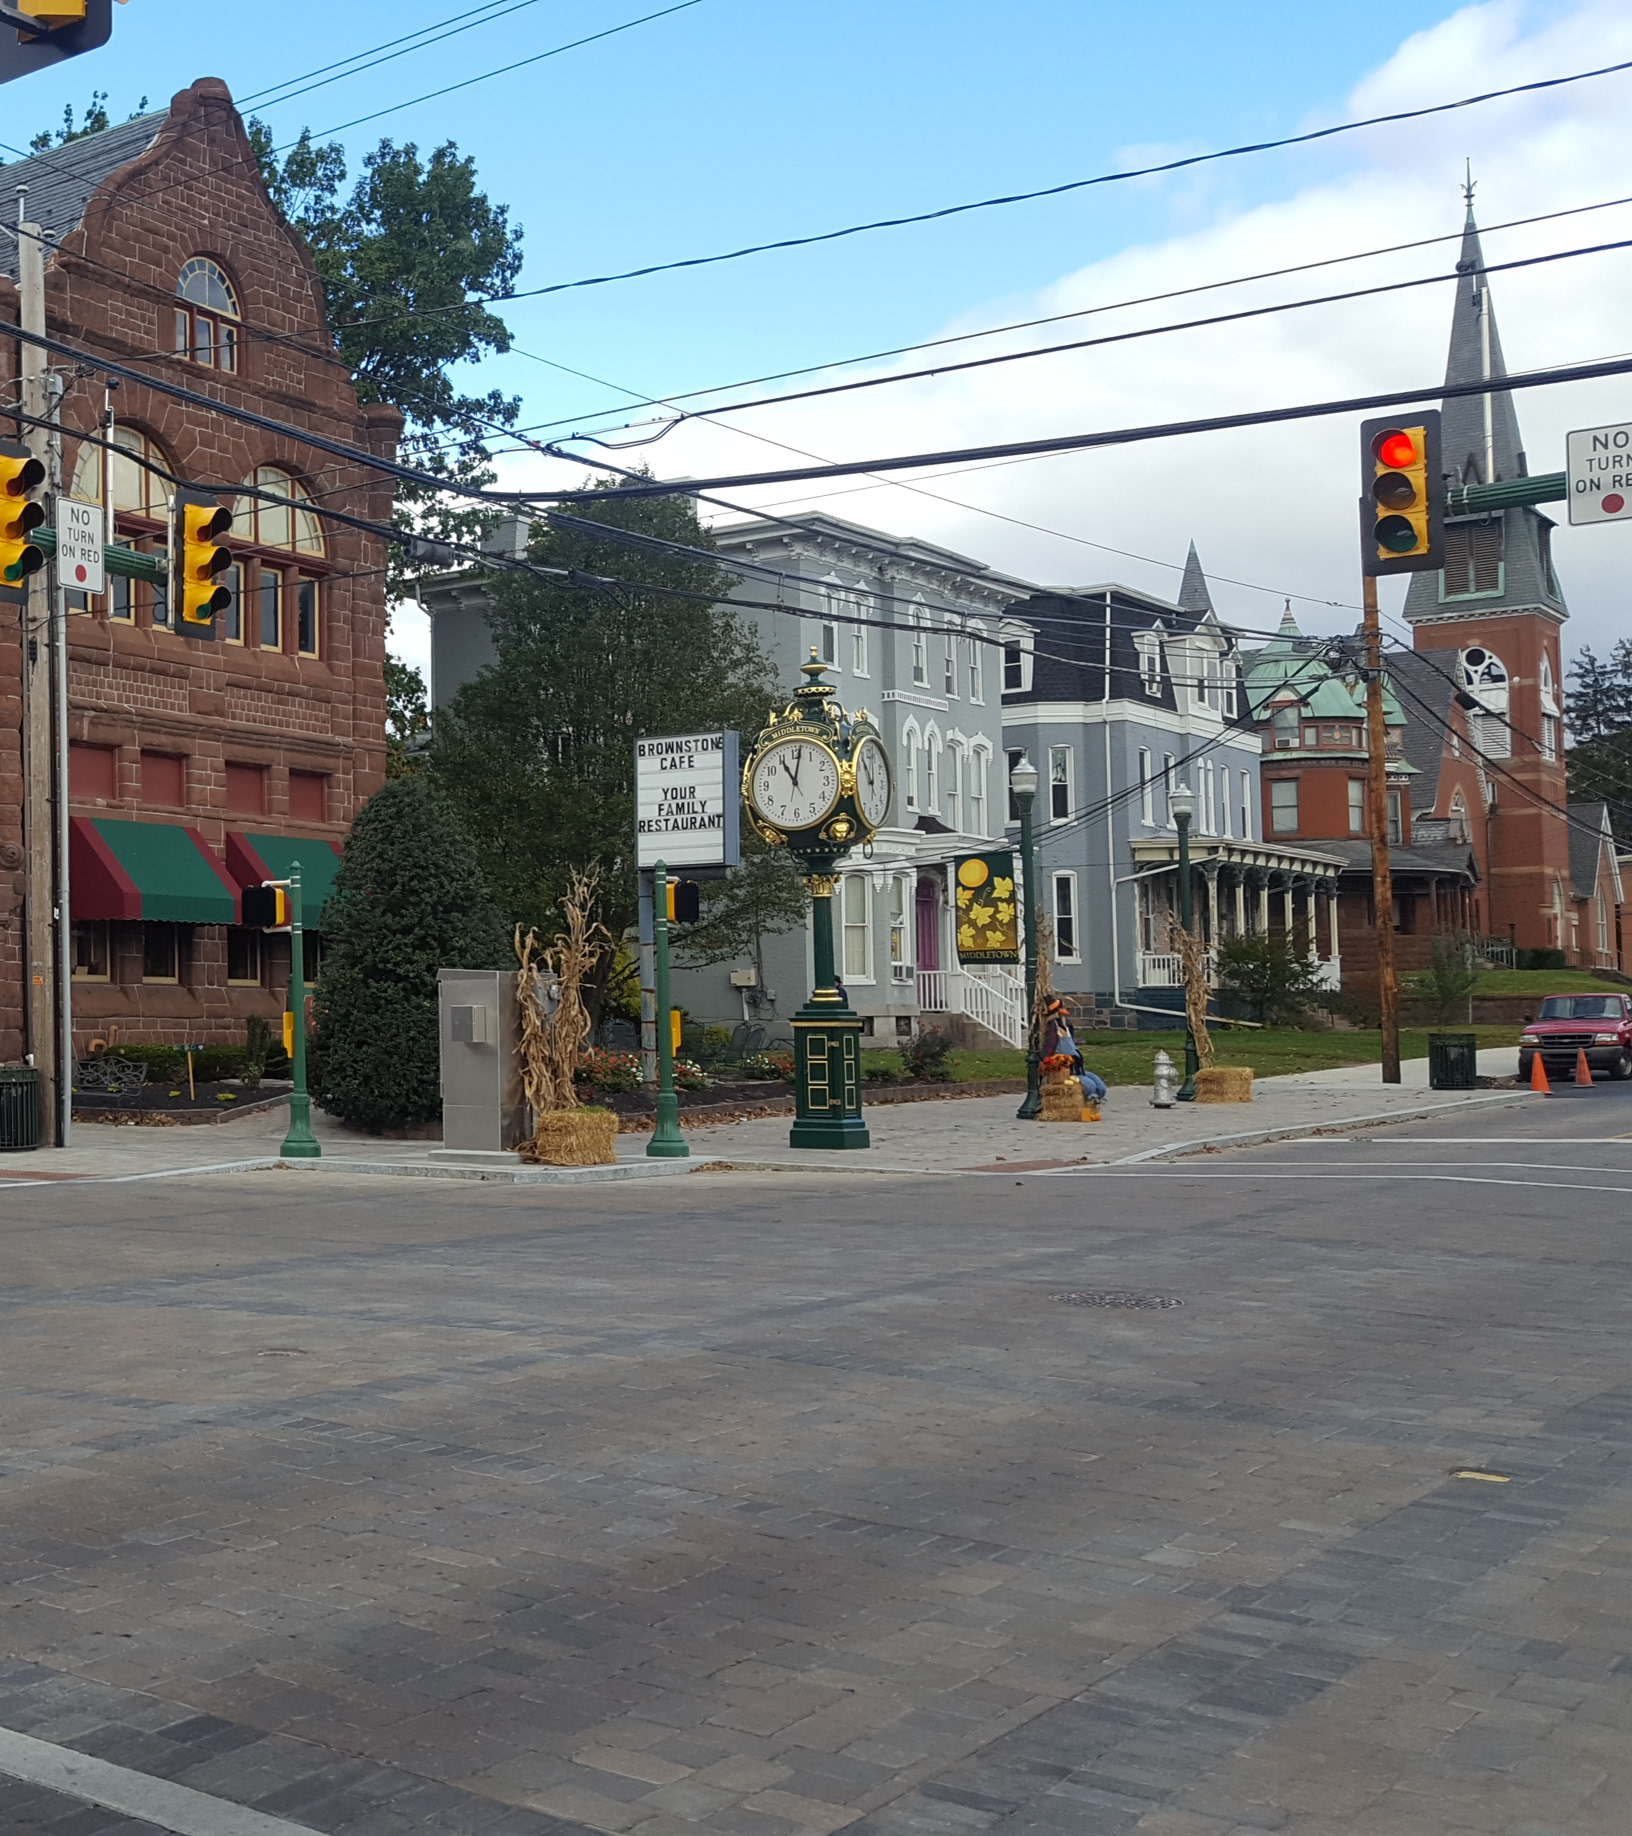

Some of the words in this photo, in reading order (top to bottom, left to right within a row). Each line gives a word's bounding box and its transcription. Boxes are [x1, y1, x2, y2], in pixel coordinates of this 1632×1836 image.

[1592, 430, 1630, 452] NO
[1575, 477, 1601, 494] ON
[70, 506, 91, 526] NO
[67, 527, 95, 545] TURN
[61, 543, 76, 559] ON
[80, 548, 100, 564] RED
[771, 725, 821, 740] MIDDLETOWN
[638, 736, 724, 757] BROWNSTONE
[791, 748, 801, 760] 12
[808, 751, 813, 762] 1
[660, 755, 695, 770] CAFE
[819, 760, 826, 772] 2
[766, 765, 777, 777] 10
[763, 781, 770, 792] 9
[823, 775, 830, 787] 3
[662, 786, 696, 801] YOUR
[818, 791, 827, 802] 4
[767, 795, 774, 807] 8
[657, 800, 708, 817] FAMILY
[780, 805, 787, 816] 7
[793, 807, 800, 818] 6
[808, 802, 816, 814] 5
[638, 815, 724, 833] RESTAURANT
[959, 950, 1019, 959] MIDDLETOWN
